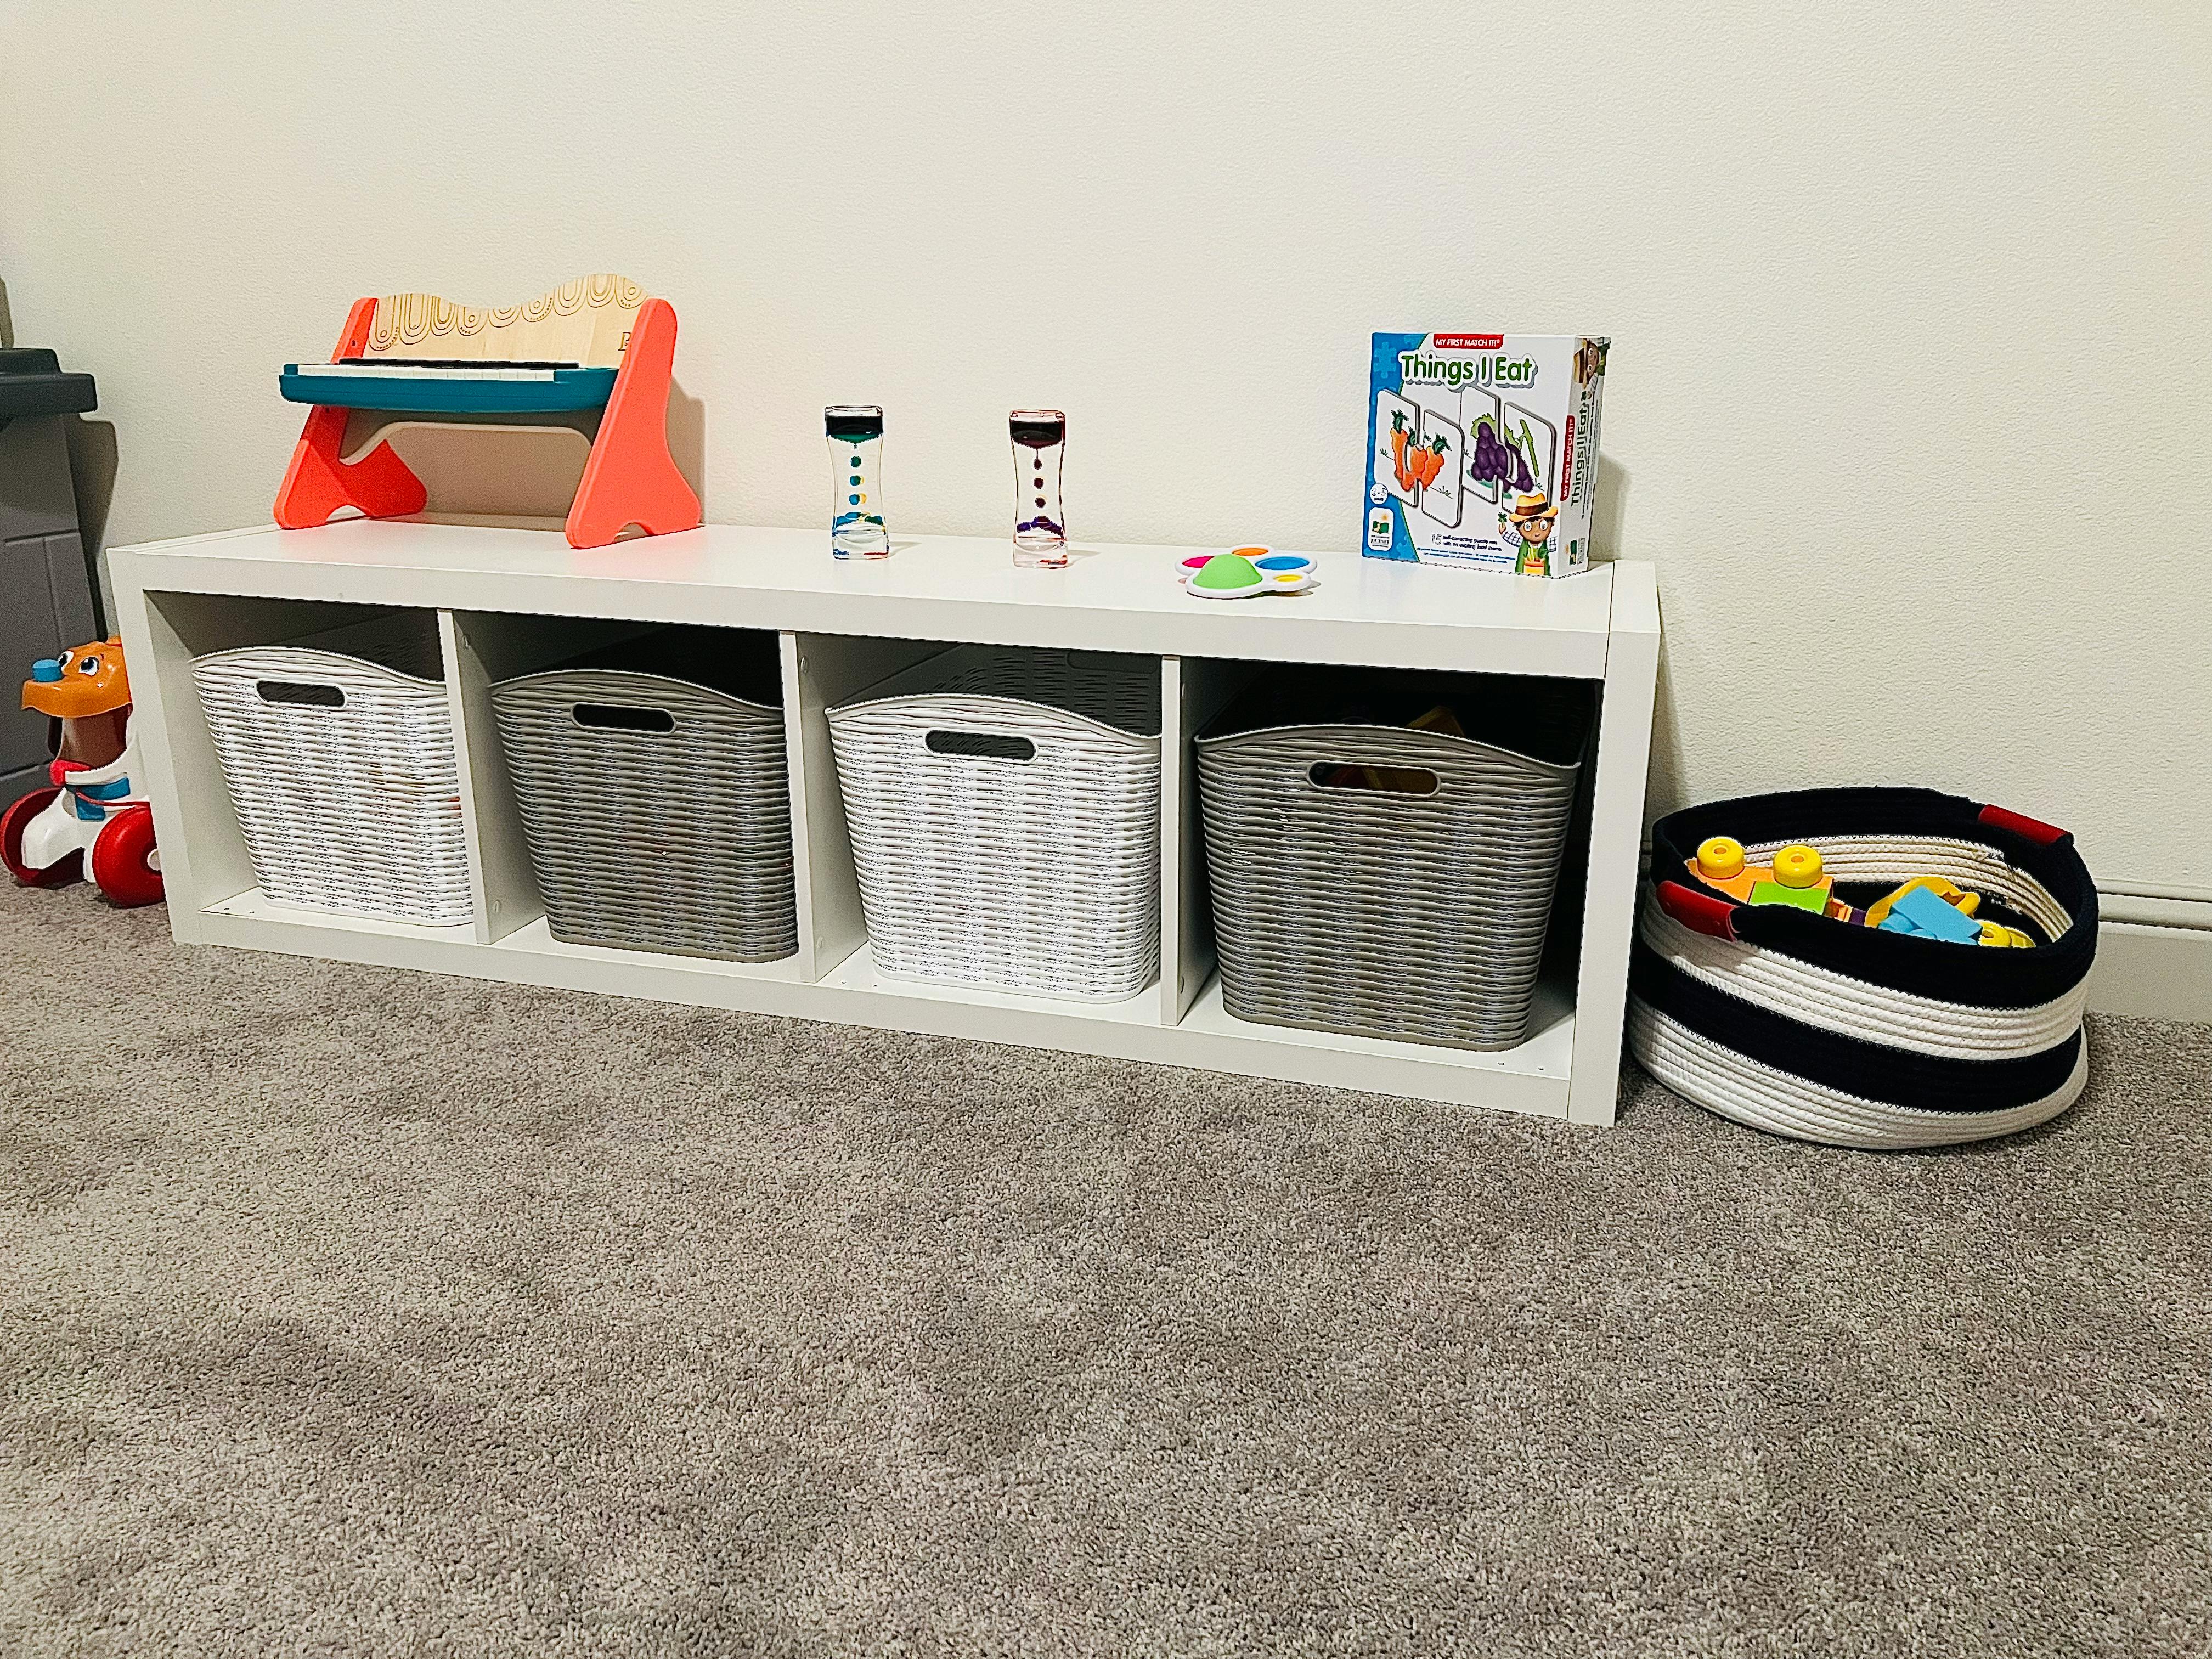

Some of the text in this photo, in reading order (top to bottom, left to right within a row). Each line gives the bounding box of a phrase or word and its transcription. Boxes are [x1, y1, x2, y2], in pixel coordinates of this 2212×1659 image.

[1447, 338, 1464, 347] FIRST
[1464, 338, 1488, 347] MATCH
[1401, 353, 1532, 386] Things I Eat
[1577, 408, 1588, 435] Eat
[1571, 450, 1585, 507] Things
[1563, 485, 1568, 498] MY
[1431, 533, 1442, 545] 15
